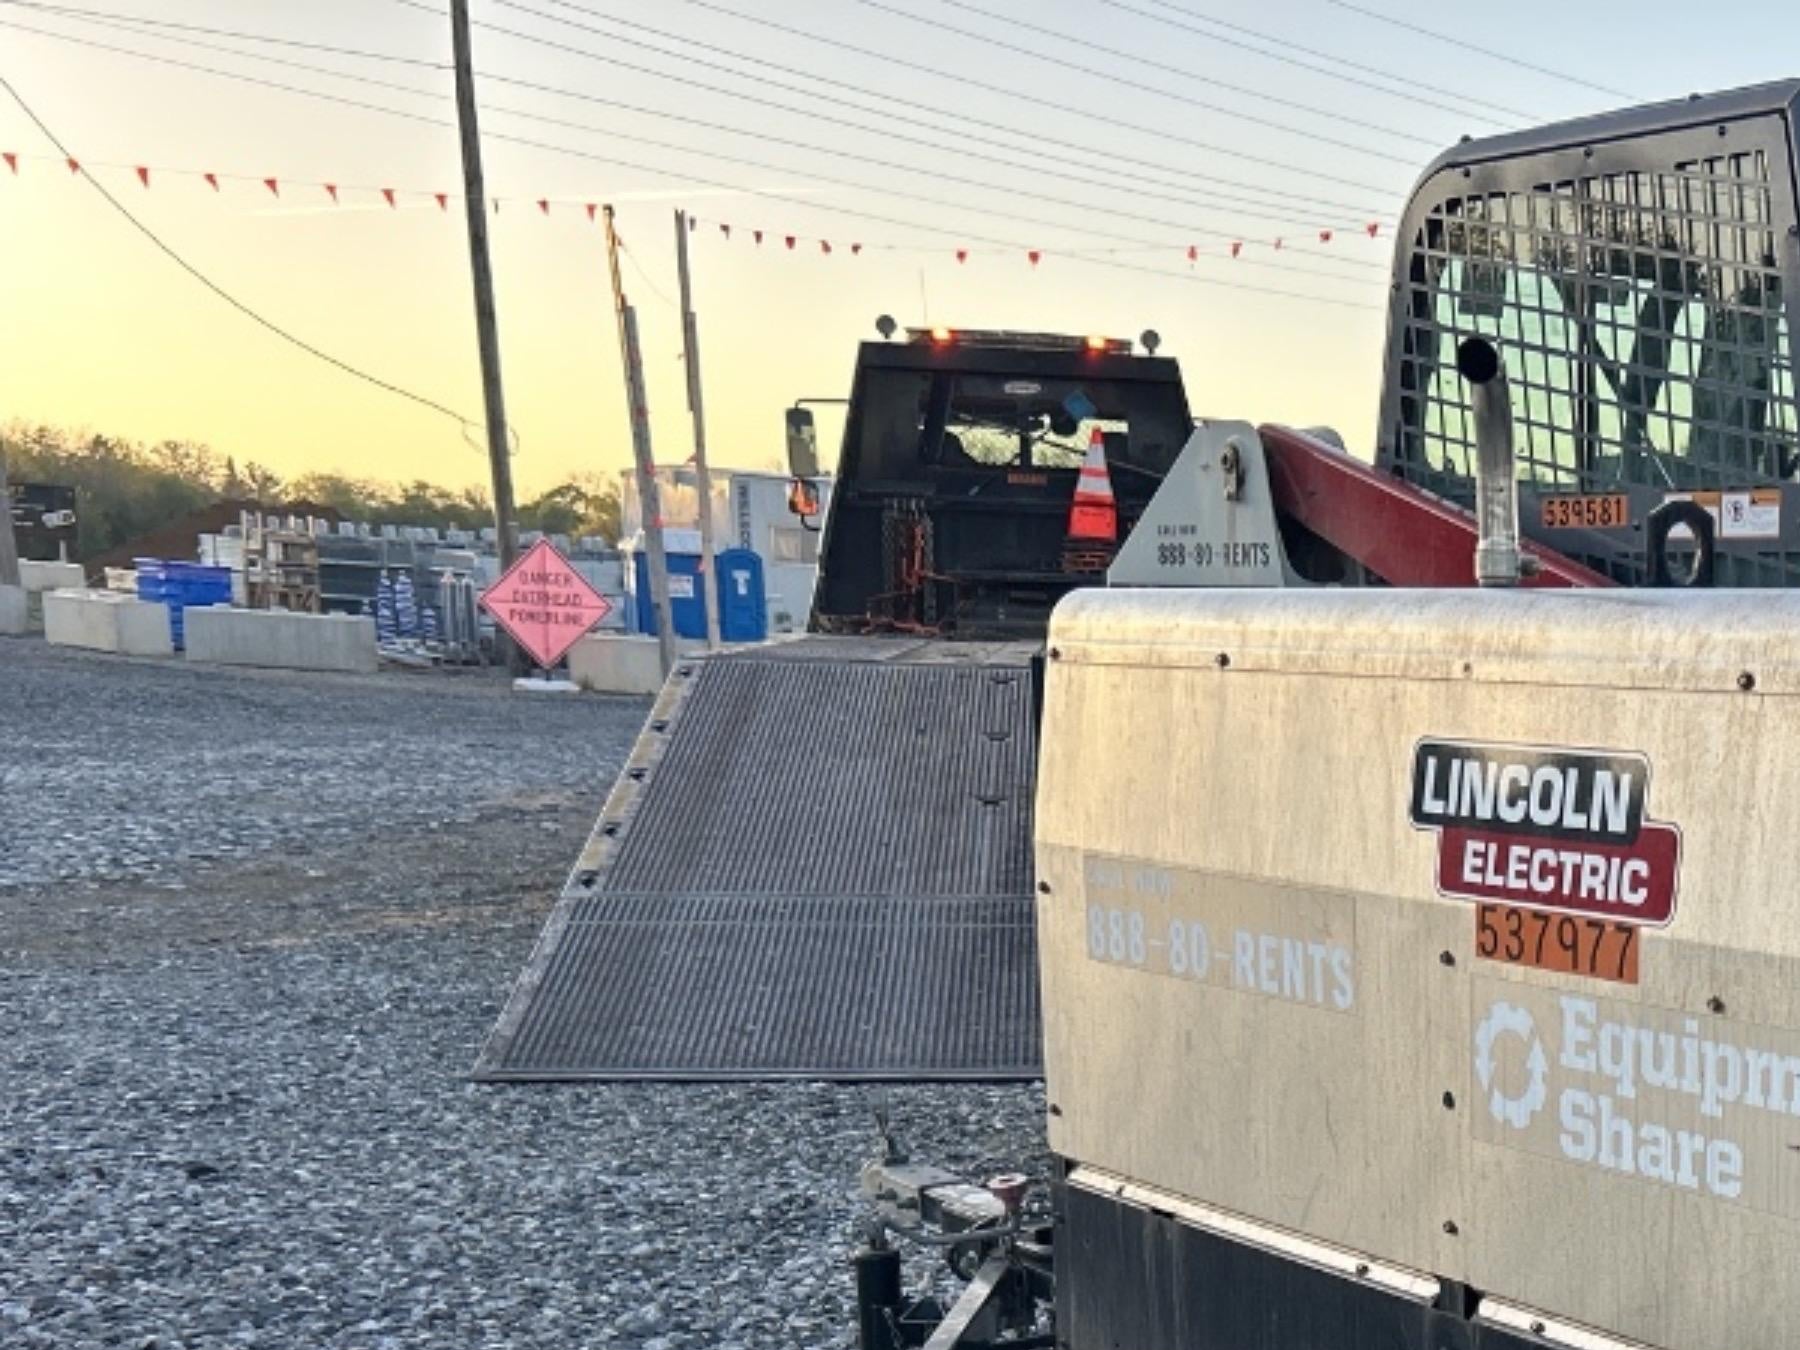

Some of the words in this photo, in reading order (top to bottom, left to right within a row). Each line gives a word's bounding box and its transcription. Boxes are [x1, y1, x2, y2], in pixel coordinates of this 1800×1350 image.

[1544, 496, 1623, 526] 539581
[519, 570, 573, 588] DANGER
[1157, 541, 1270, 568] 888-80-RENTS
[1421, 755, 1633, 836] LINCOLN
[1462, 839, 1650, 906] ELECTRIC
[1088, 904, 1355, 1010] 888-80-RENTS
[1479, 902, 1635, 980] 537977
[1558, 1087, 1745, 1199] Share
